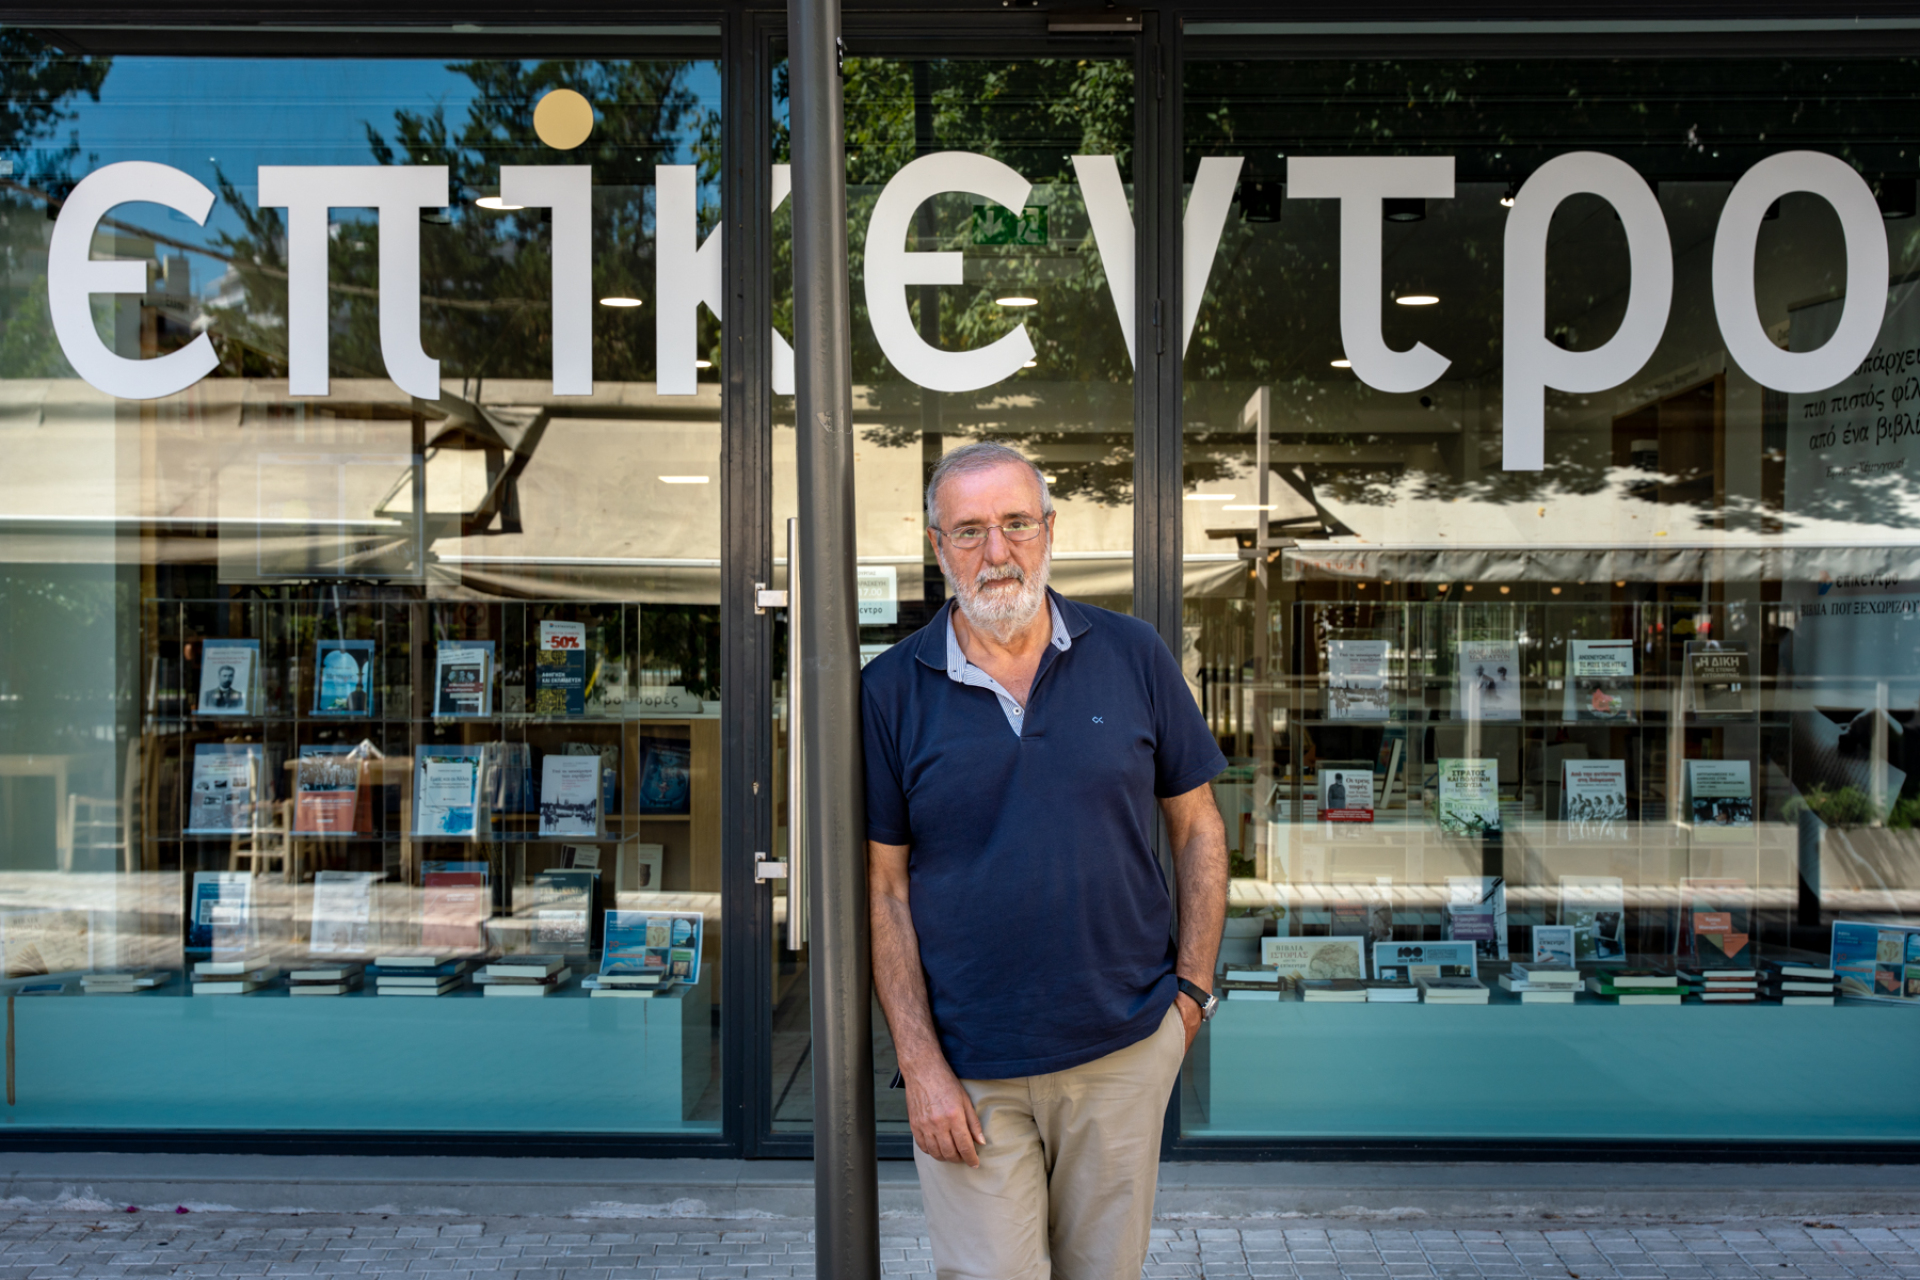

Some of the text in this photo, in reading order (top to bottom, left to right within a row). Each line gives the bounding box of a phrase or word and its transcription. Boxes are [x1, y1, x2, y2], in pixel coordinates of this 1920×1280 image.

[1803, 400, 1826, 418] πιο
[1830, 384, 1885, 413] πιστός
[1809, 424, 1836, 450] από
[1842, 421, 1869, 445] ένα
[1800, 603, 1827, 617] ΒΙΒΛΙΑ
[1830, 603, 1852, 616] ΠΟΥ
[545, 636, 580, 649] -50%
[1699, 656, 1740, 667] Η ΔΙΚΗ
[1270, 951, 1309, 959] ΙΣΤΟΡΙΑΣ
